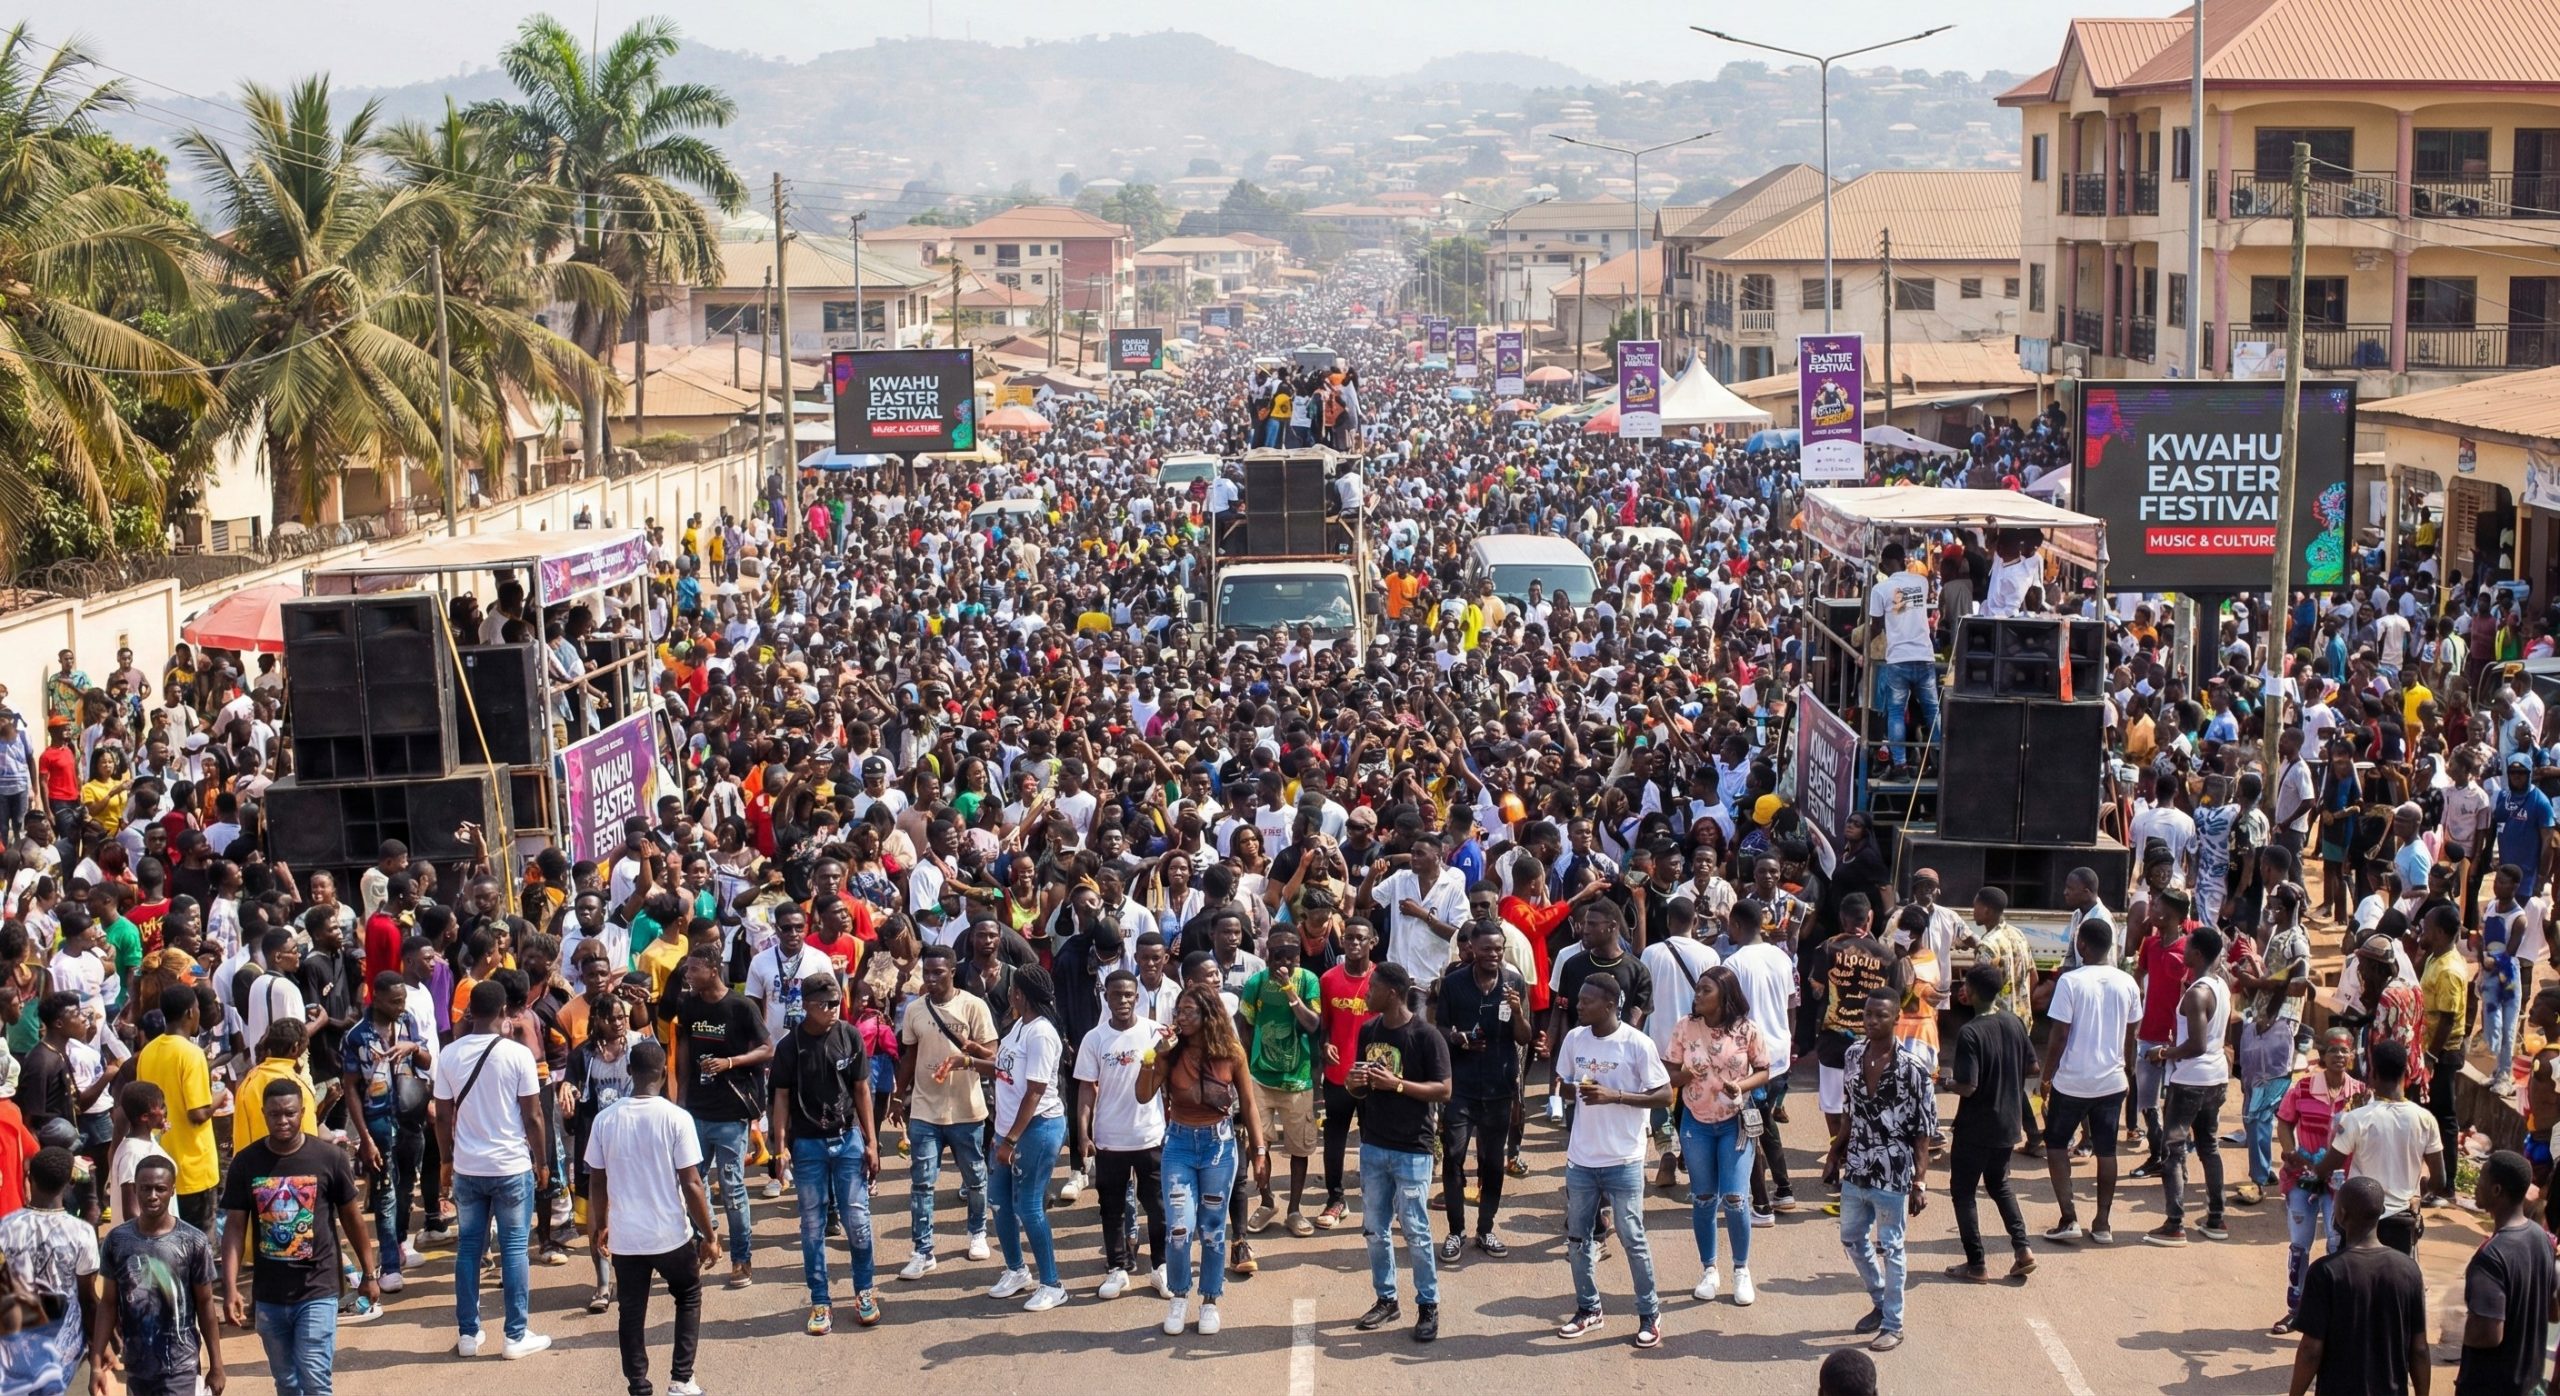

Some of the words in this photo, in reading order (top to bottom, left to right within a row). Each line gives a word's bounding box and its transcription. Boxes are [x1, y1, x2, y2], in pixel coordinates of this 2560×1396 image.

[1809, 363, 1855, 373] FESTIVAL
[869, 375, 939, 391] KWAHU
[870, 391, 939, 406] EASTER
[867, 406, 943, 421] FESTIVAL
[2147, 433, 2282, 461] KWAHU
[2148, 465, 2280, 492] EASTER
[2150, 534, 2196, 547] MUSIC
[2200, 534, 2210, 547] &
[1809, 729, 1839, 778] KWAHU
[591, 750, 633, 797] KWAHU
[1808, 759, 1836, 810] EASTER
[593, 781, 636, 828] EASTER
[1807, 788, 1837, 838] FESTIVAL
[593, 811, 638, 858] FESTIV
